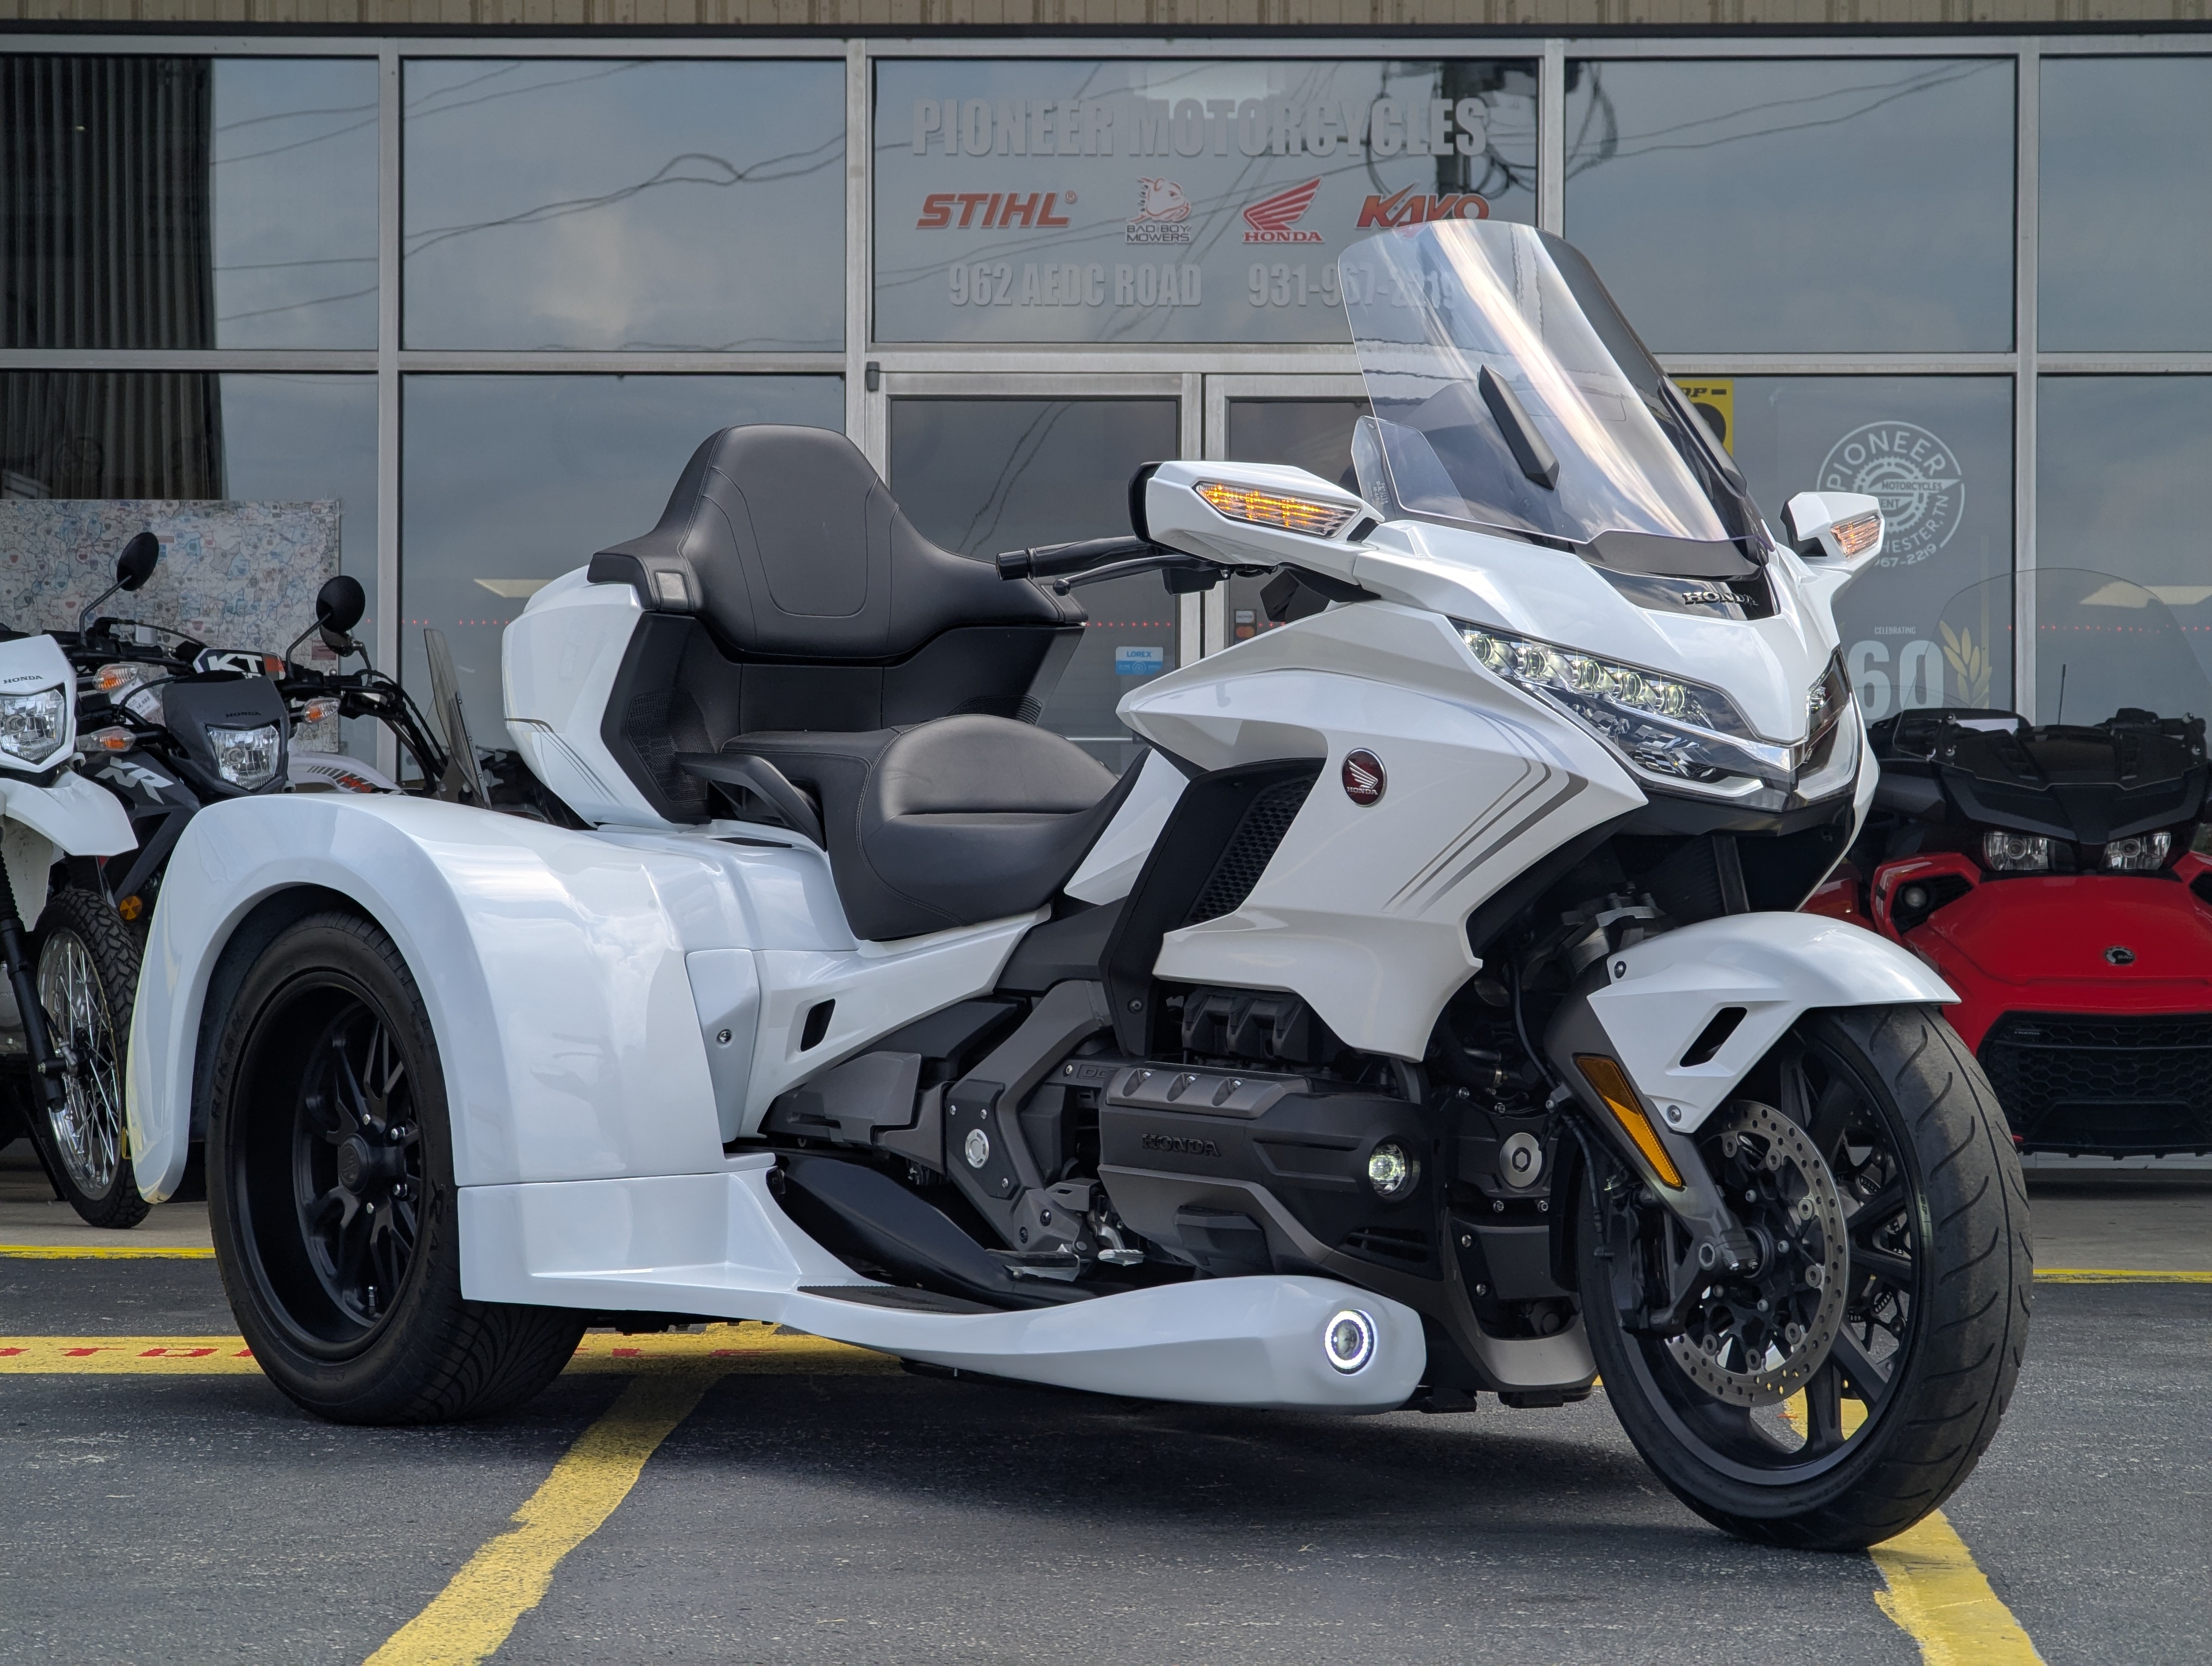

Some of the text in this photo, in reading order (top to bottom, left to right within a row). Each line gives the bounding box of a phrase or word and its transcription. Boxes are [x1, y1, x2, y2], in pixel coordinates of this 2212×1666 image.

[913, 98, 1487, 156] PIONEER MOTORCYCLES
[916, 193, 1069, 228] STIHL
[1127, 233, 1189, 242] MOWERS
[1244, 231, 1323, 242] HONDA
[949, 262, 1201, 307] 962 AEDC ROAD
[1827, 431, 1946, 491] PIONEER
[1682, 591, 1759, 606] HONDA
[1127, 650, 1152, 658] LOREX
[3, 675, 43, 684] HONDA
[1847, 640, 1944, 719] 60
[1347, 786, 1379, 795] HONDA
[1142, 1133, 1221, 1158] HONDA
